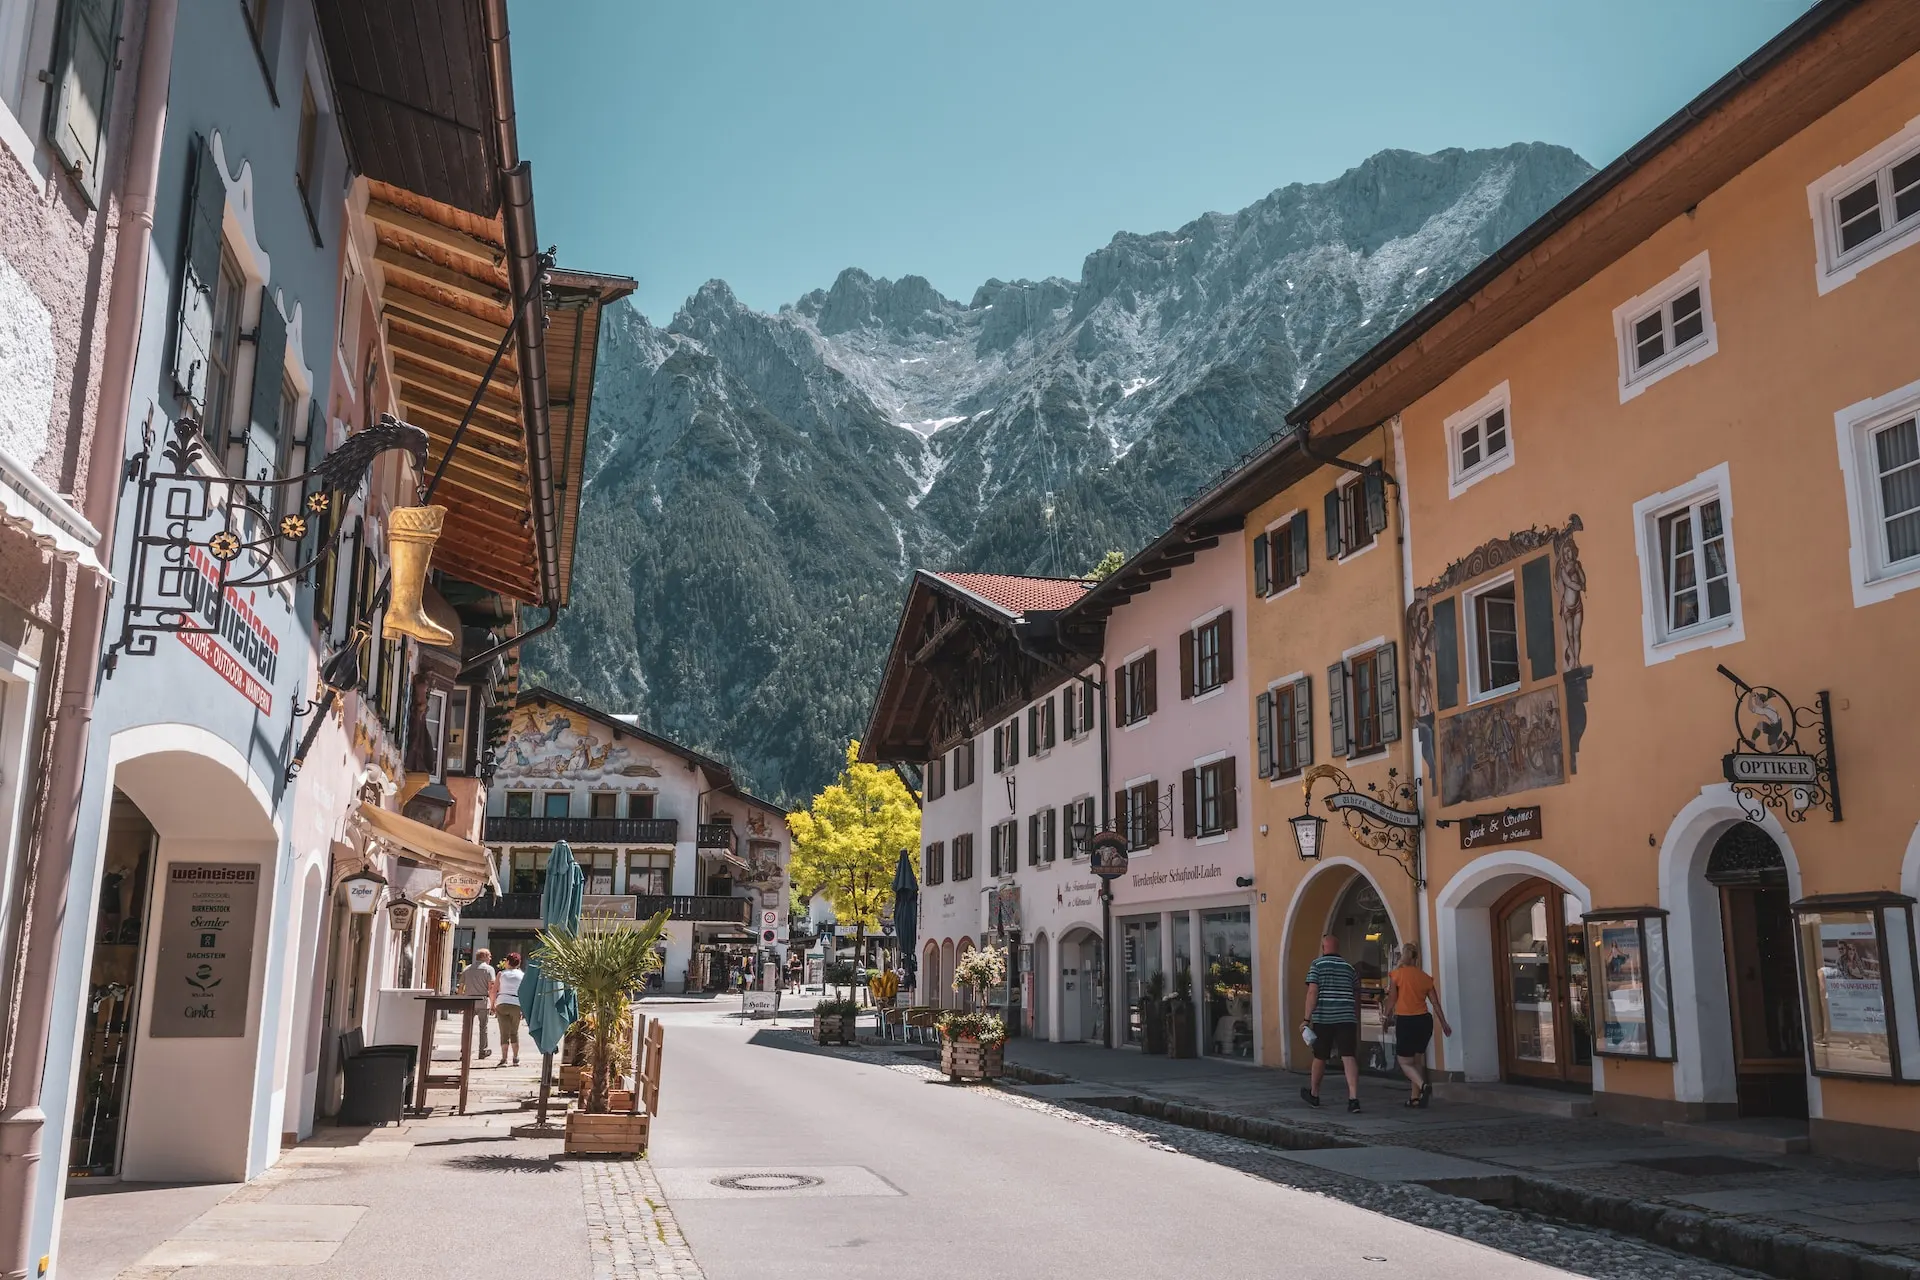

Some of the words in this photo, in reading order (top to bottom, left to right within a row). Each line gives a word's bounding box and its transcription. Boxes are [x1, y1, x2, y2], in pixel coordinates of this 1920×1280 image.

[181, 622, 211, 659] SCHUHE
[213, 646, 243, 687] OUTDOOR
[245, 675, 271, 712] WANDERN
[1740, 760, 1809, 775] OPTIKER
[1342, 796, 1367, 807] Uhren
[1369, 802, 1377, 811] &
[1379, 808, 1411, 823] Schmuck
[1463, 824, 1486, 847] Jack
[1489, 819, 1499, 832] &
[1648, 833, 1656, 847] 6
[172, 867, 256, 880] weineisen
[1132, 871, 1168, 887] Werdenfelser
[351, 887, 373, 896] Zipfer
[190, 916, 230, 928] Semler
